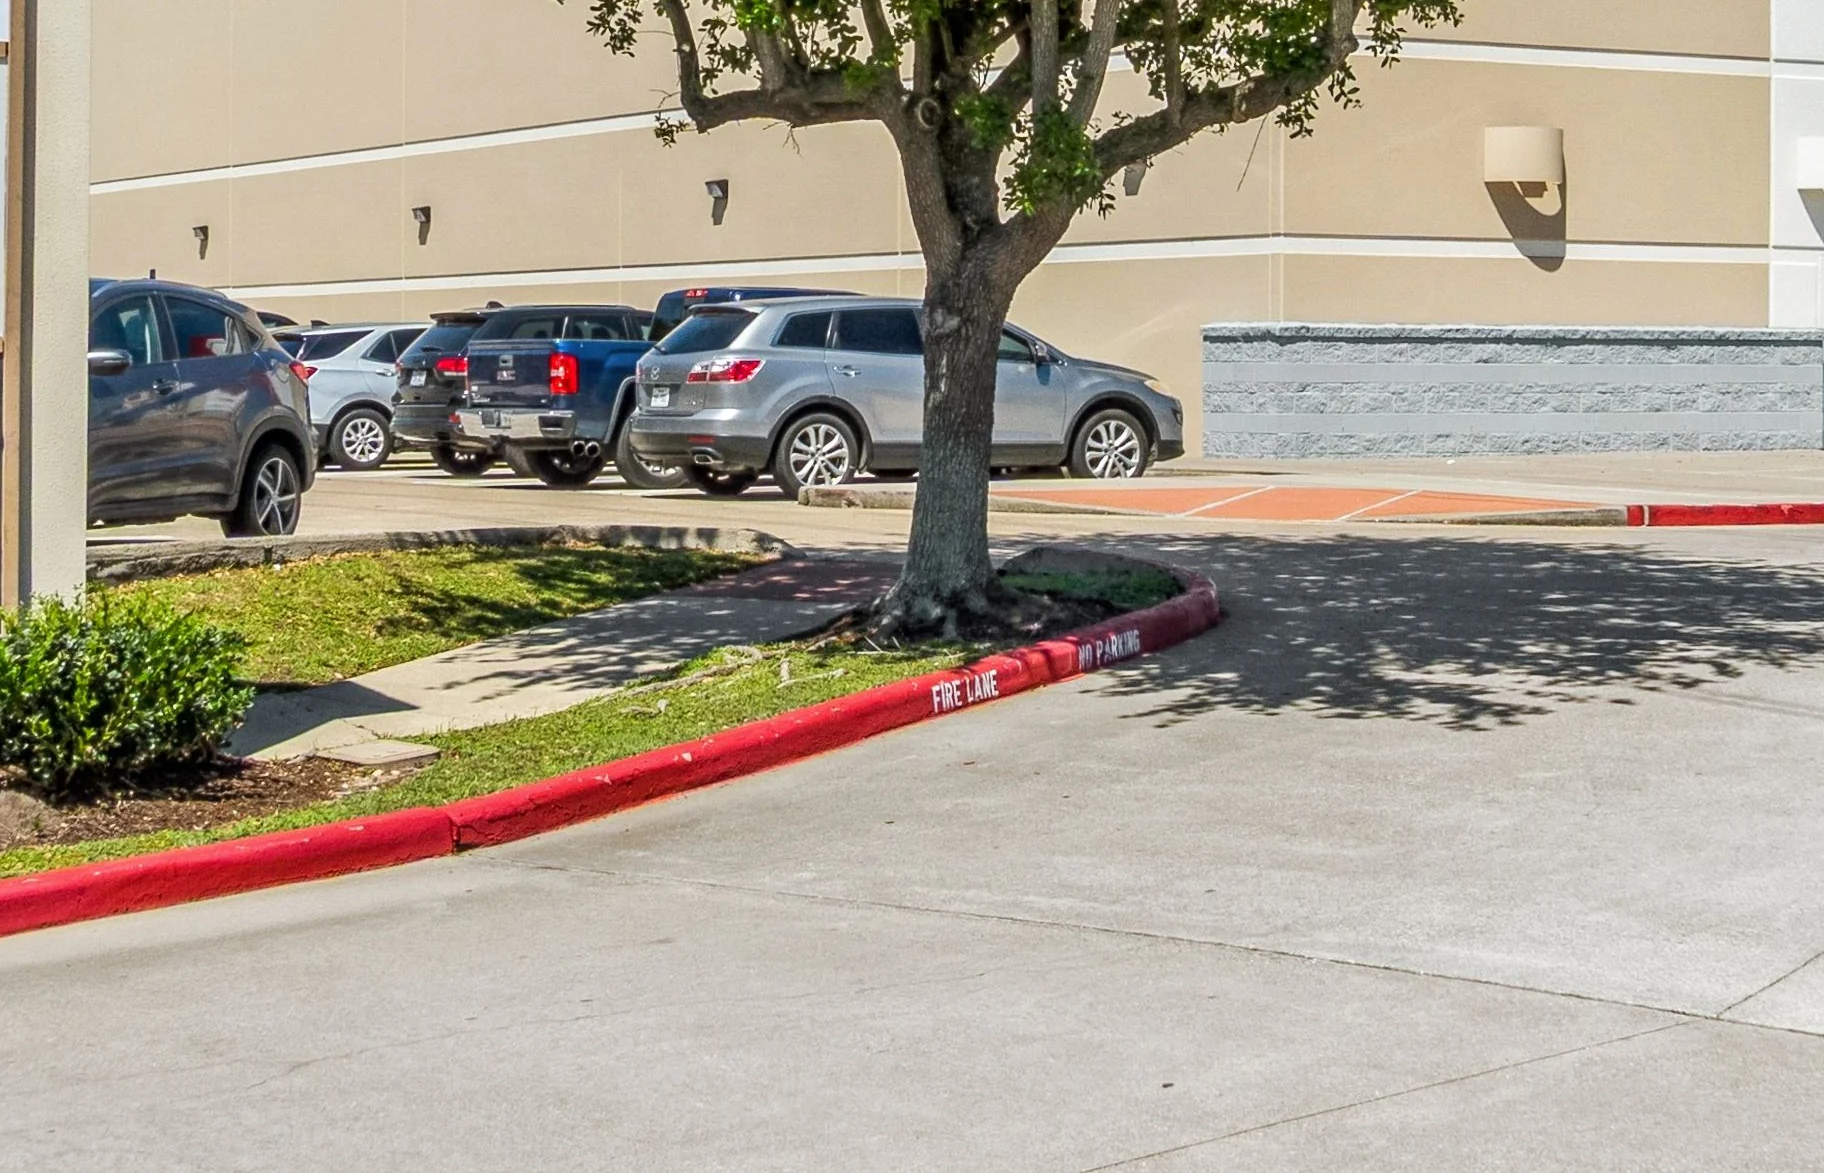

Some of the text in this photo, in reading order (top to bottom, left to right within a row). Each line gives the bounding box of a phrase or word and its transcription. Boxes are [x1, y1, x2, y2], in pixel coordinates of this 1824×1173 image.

[1078, 629, 1140, 670] NO PARKING
[931, 669, 999, 714] FIRE LANE
